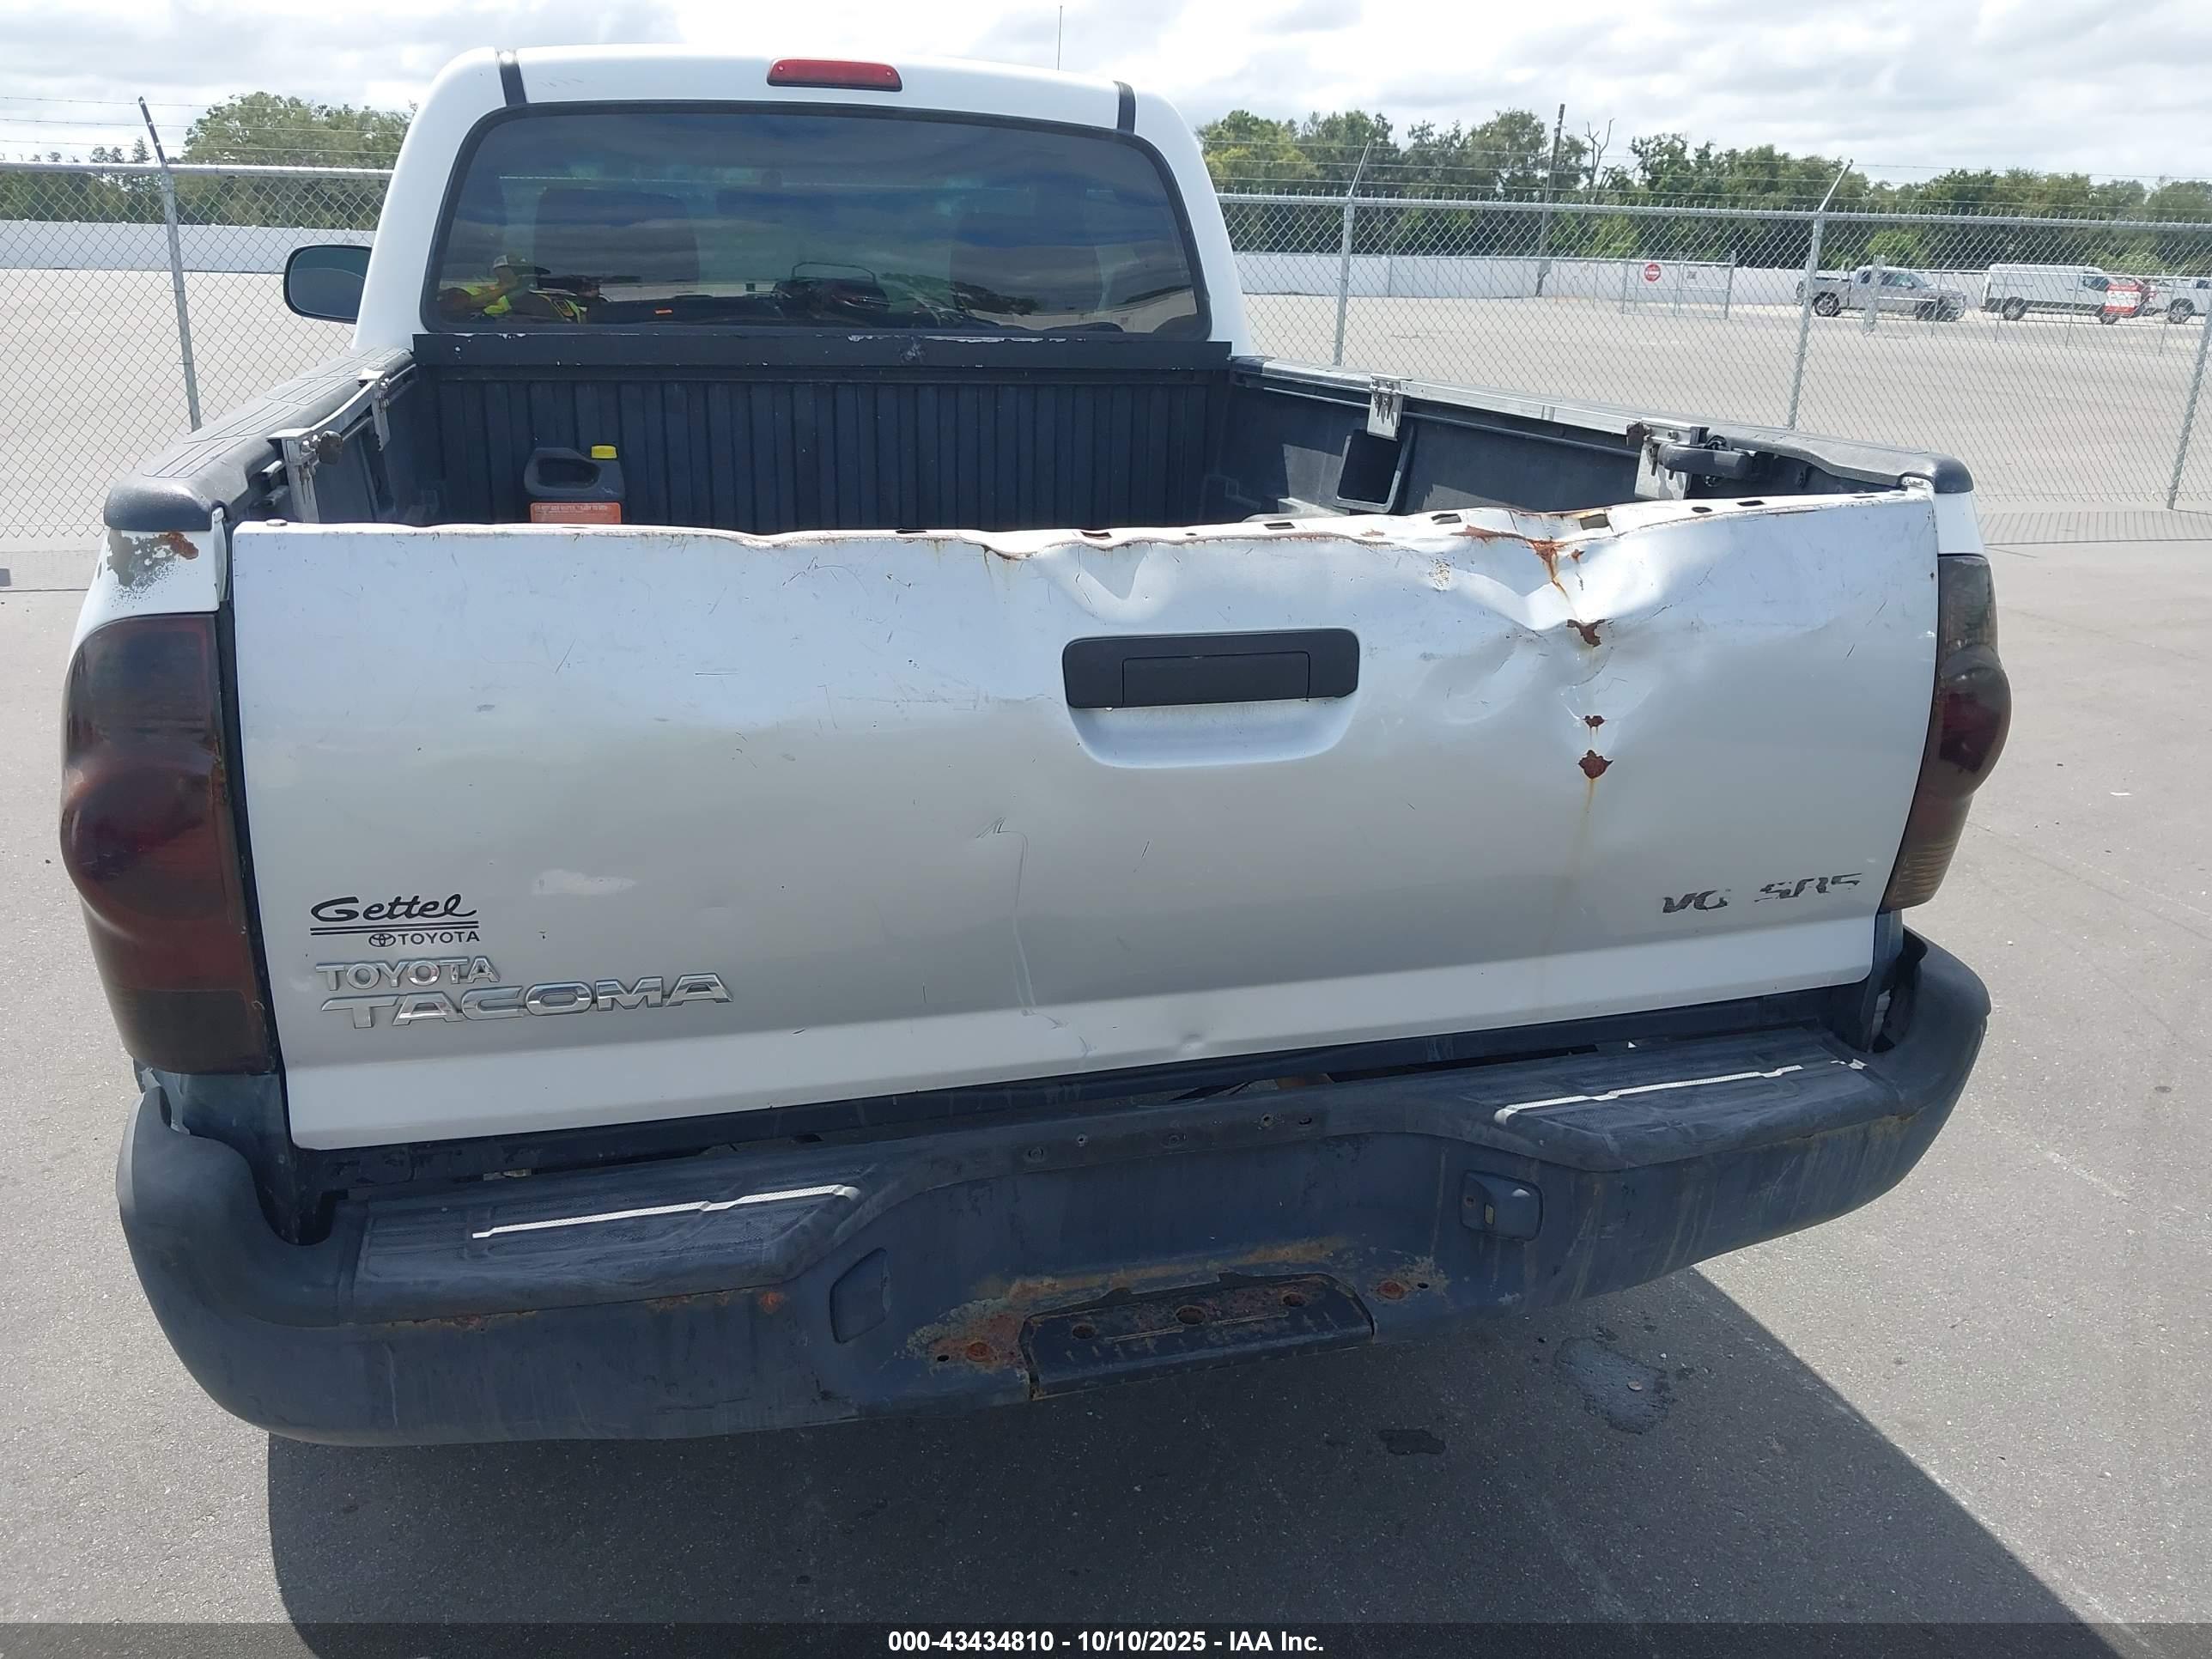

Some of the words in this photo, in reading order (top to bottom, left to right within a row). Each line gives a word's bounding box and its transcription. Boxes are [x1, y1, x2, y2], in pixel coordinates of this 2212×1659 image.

[310, 893, 477, 922] Gettel
[398, 931, 481, 945] TOYOTA
[315, 955, 501, 991] TOYOTA
[320, 971, 734, 1030] TACOMA
